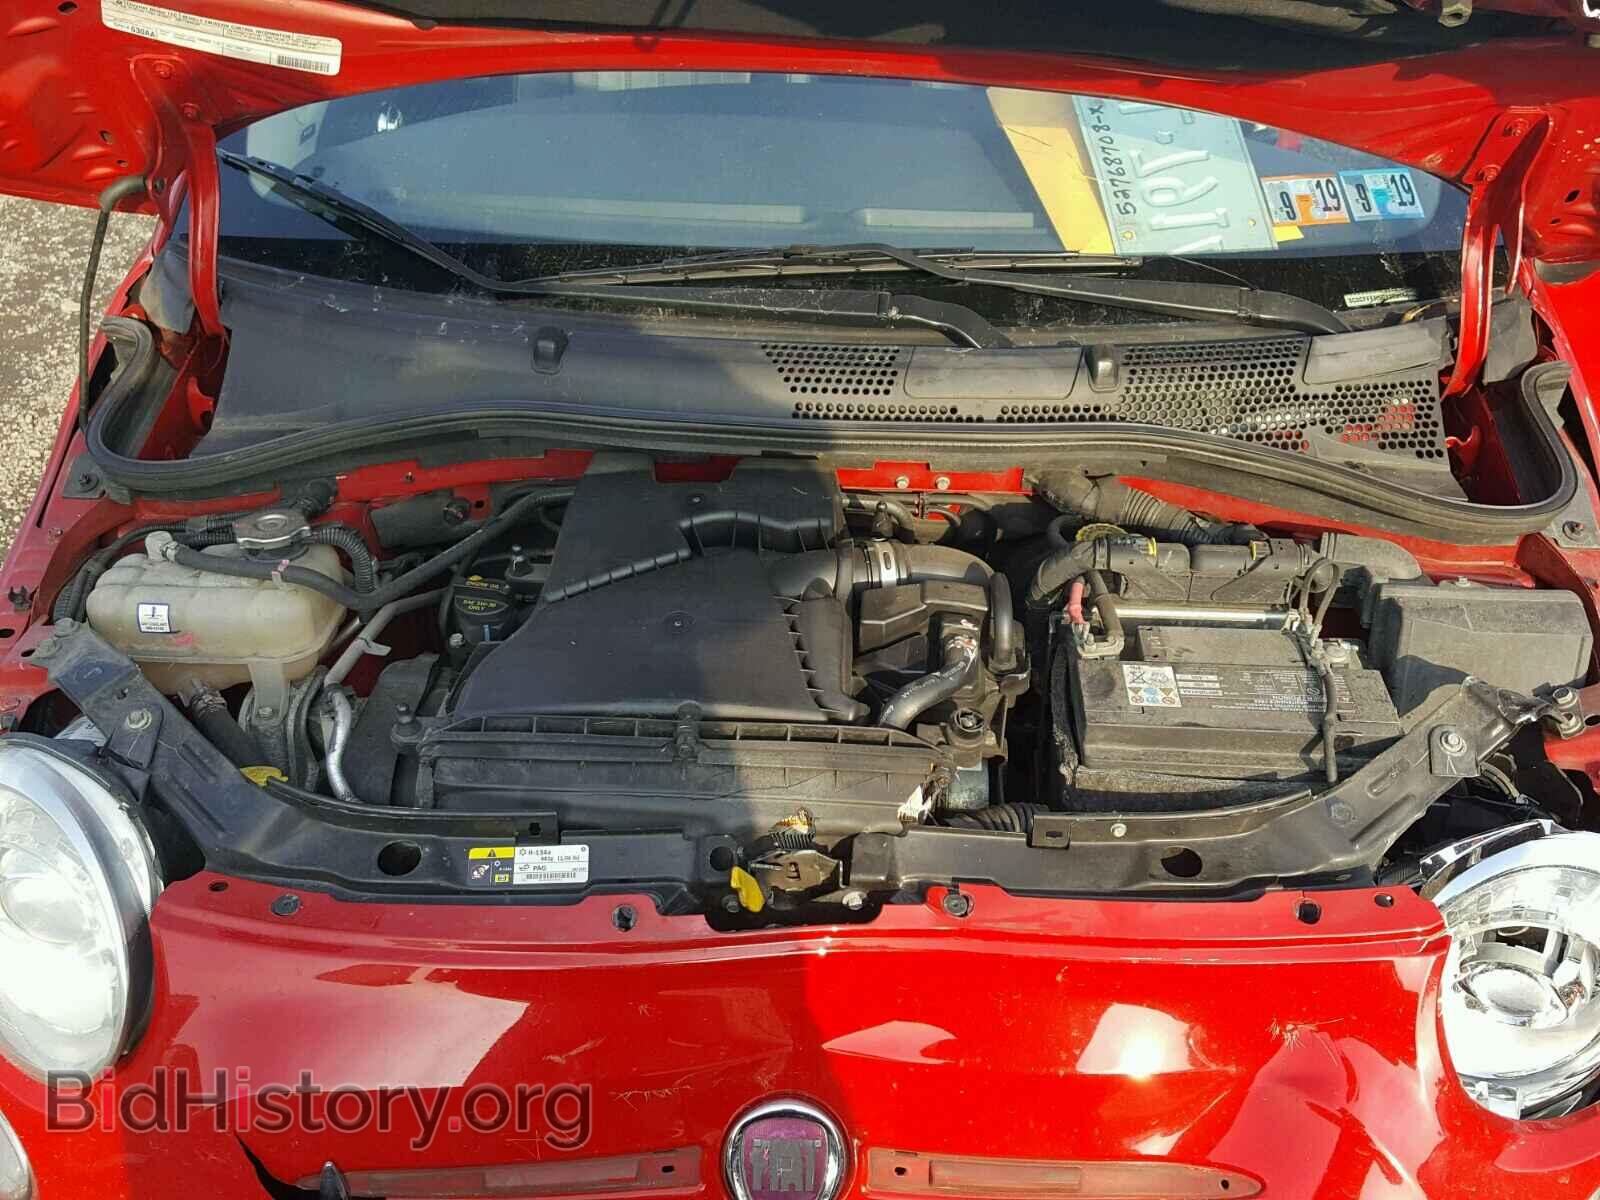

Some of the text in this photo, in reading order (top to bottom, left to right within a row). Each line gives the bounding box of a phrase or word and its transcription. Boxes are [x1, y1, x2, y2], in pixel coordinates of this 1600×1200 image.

[1279, 177, 1342, 221] 9 19
[1355, 173, 1416, 213] 9 19
